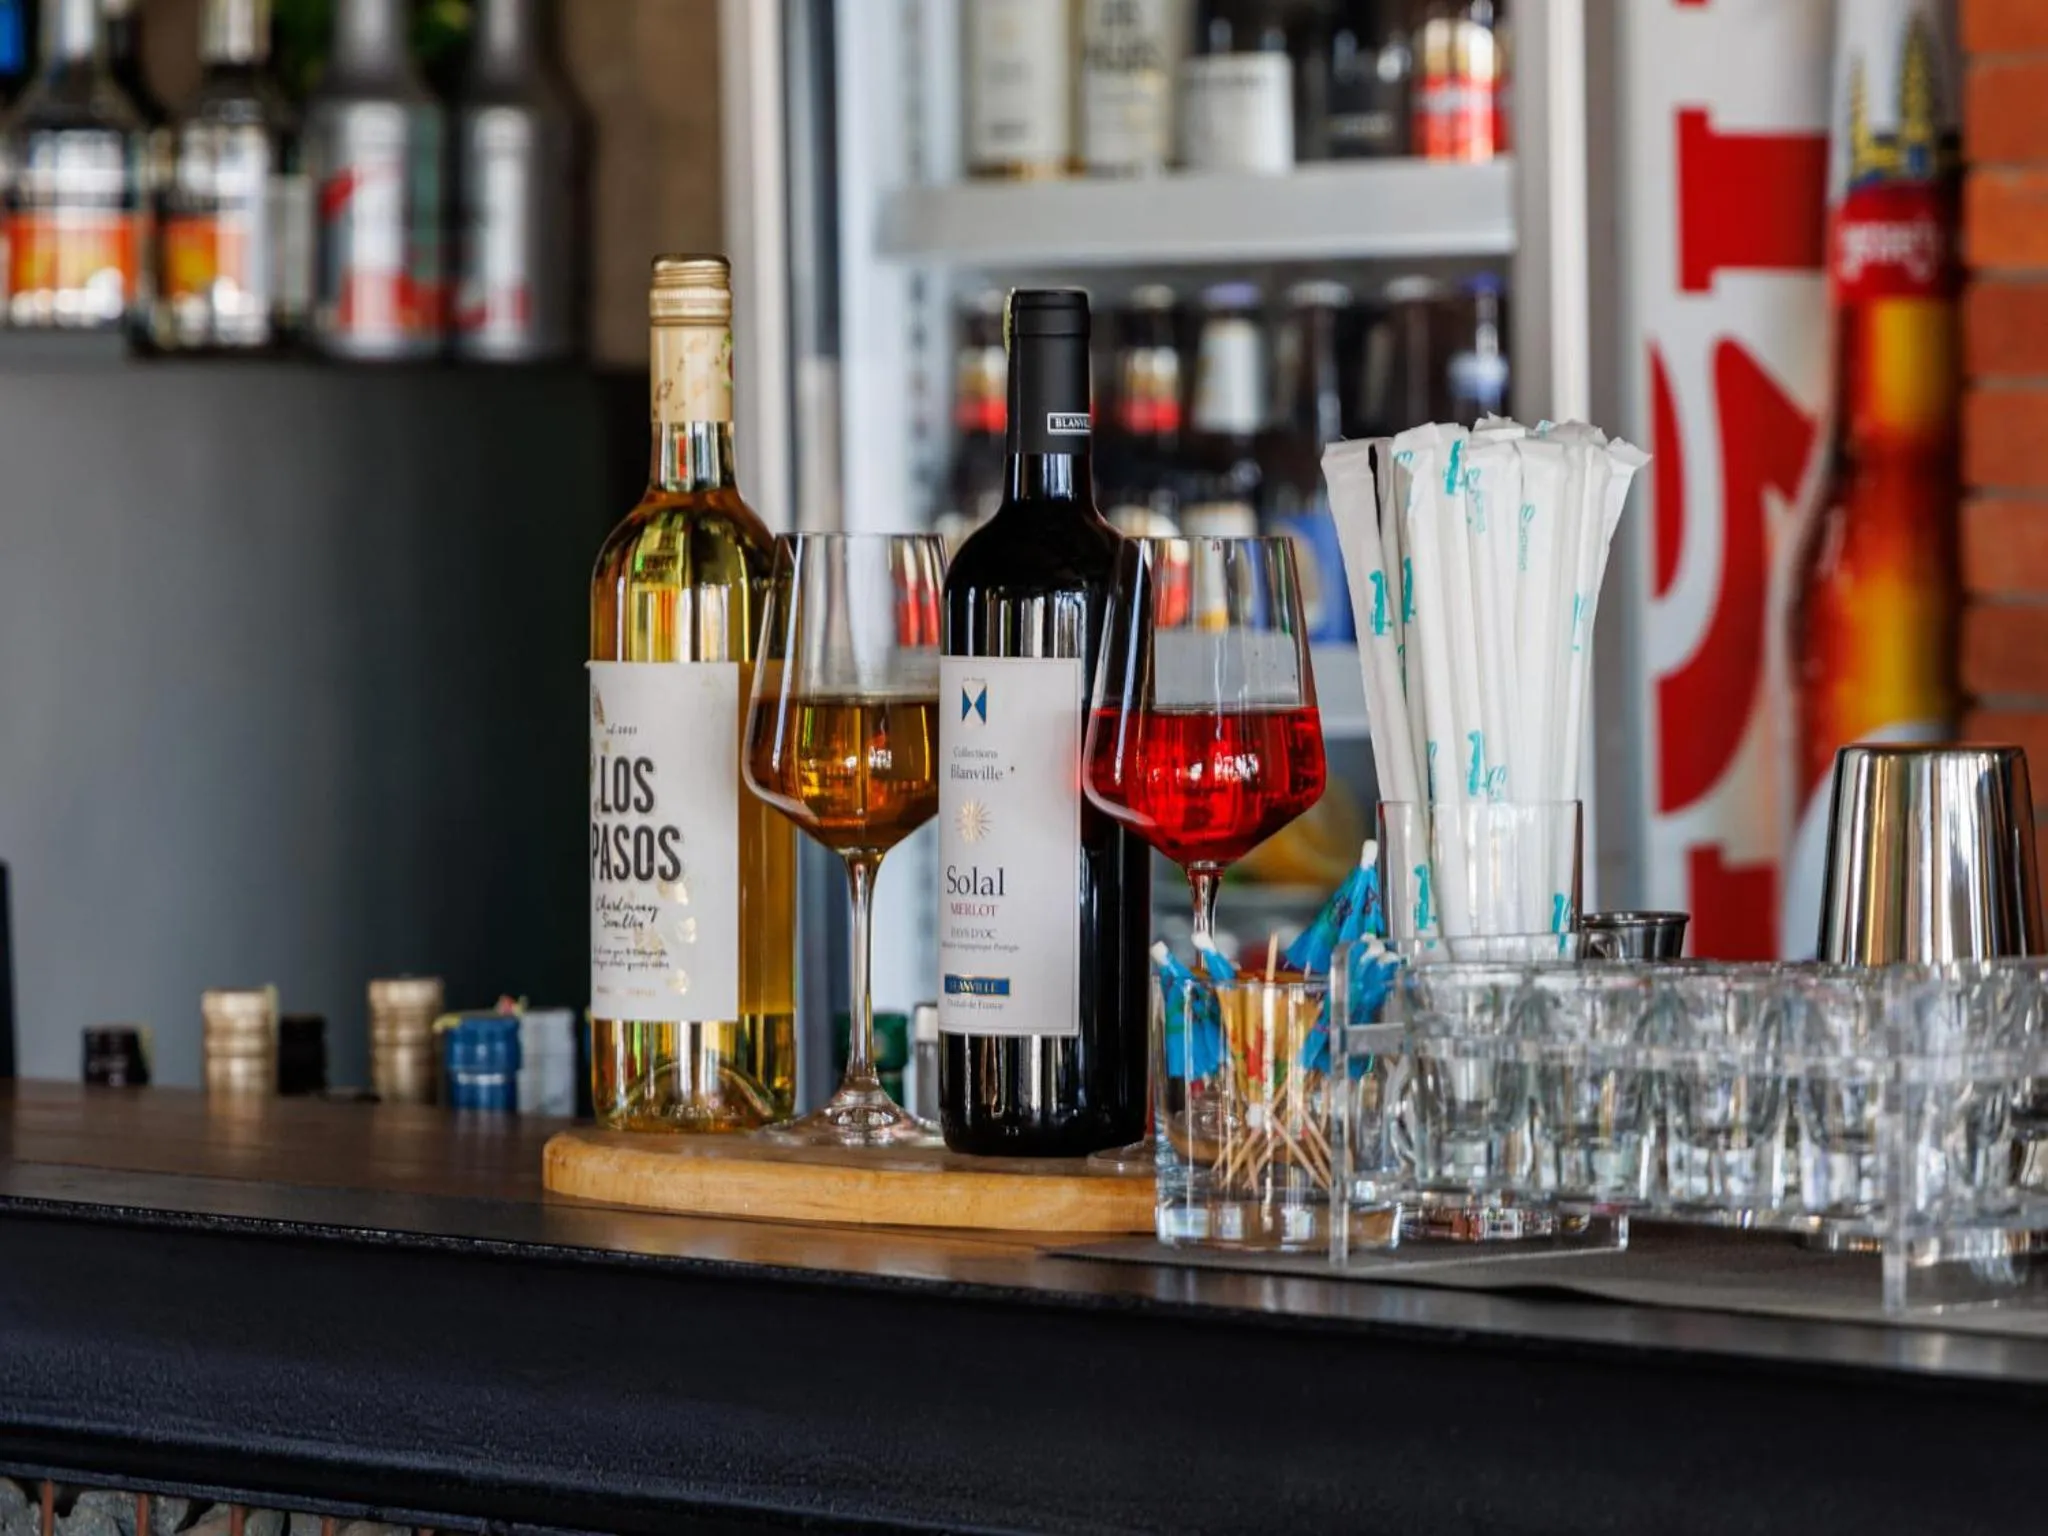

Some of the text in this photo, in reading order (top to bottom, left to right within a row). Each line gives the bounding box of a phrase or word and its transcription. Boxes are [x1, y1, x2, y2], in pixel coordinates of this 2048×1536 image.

[601, 754, 654, 814] LOS
[951, 763, 1004, 781] Blanville
[592, 822, 681, 882] PASOS
[946, 864, 1005, 896] Solal
[950, 902, 999, 917] MERLOT
